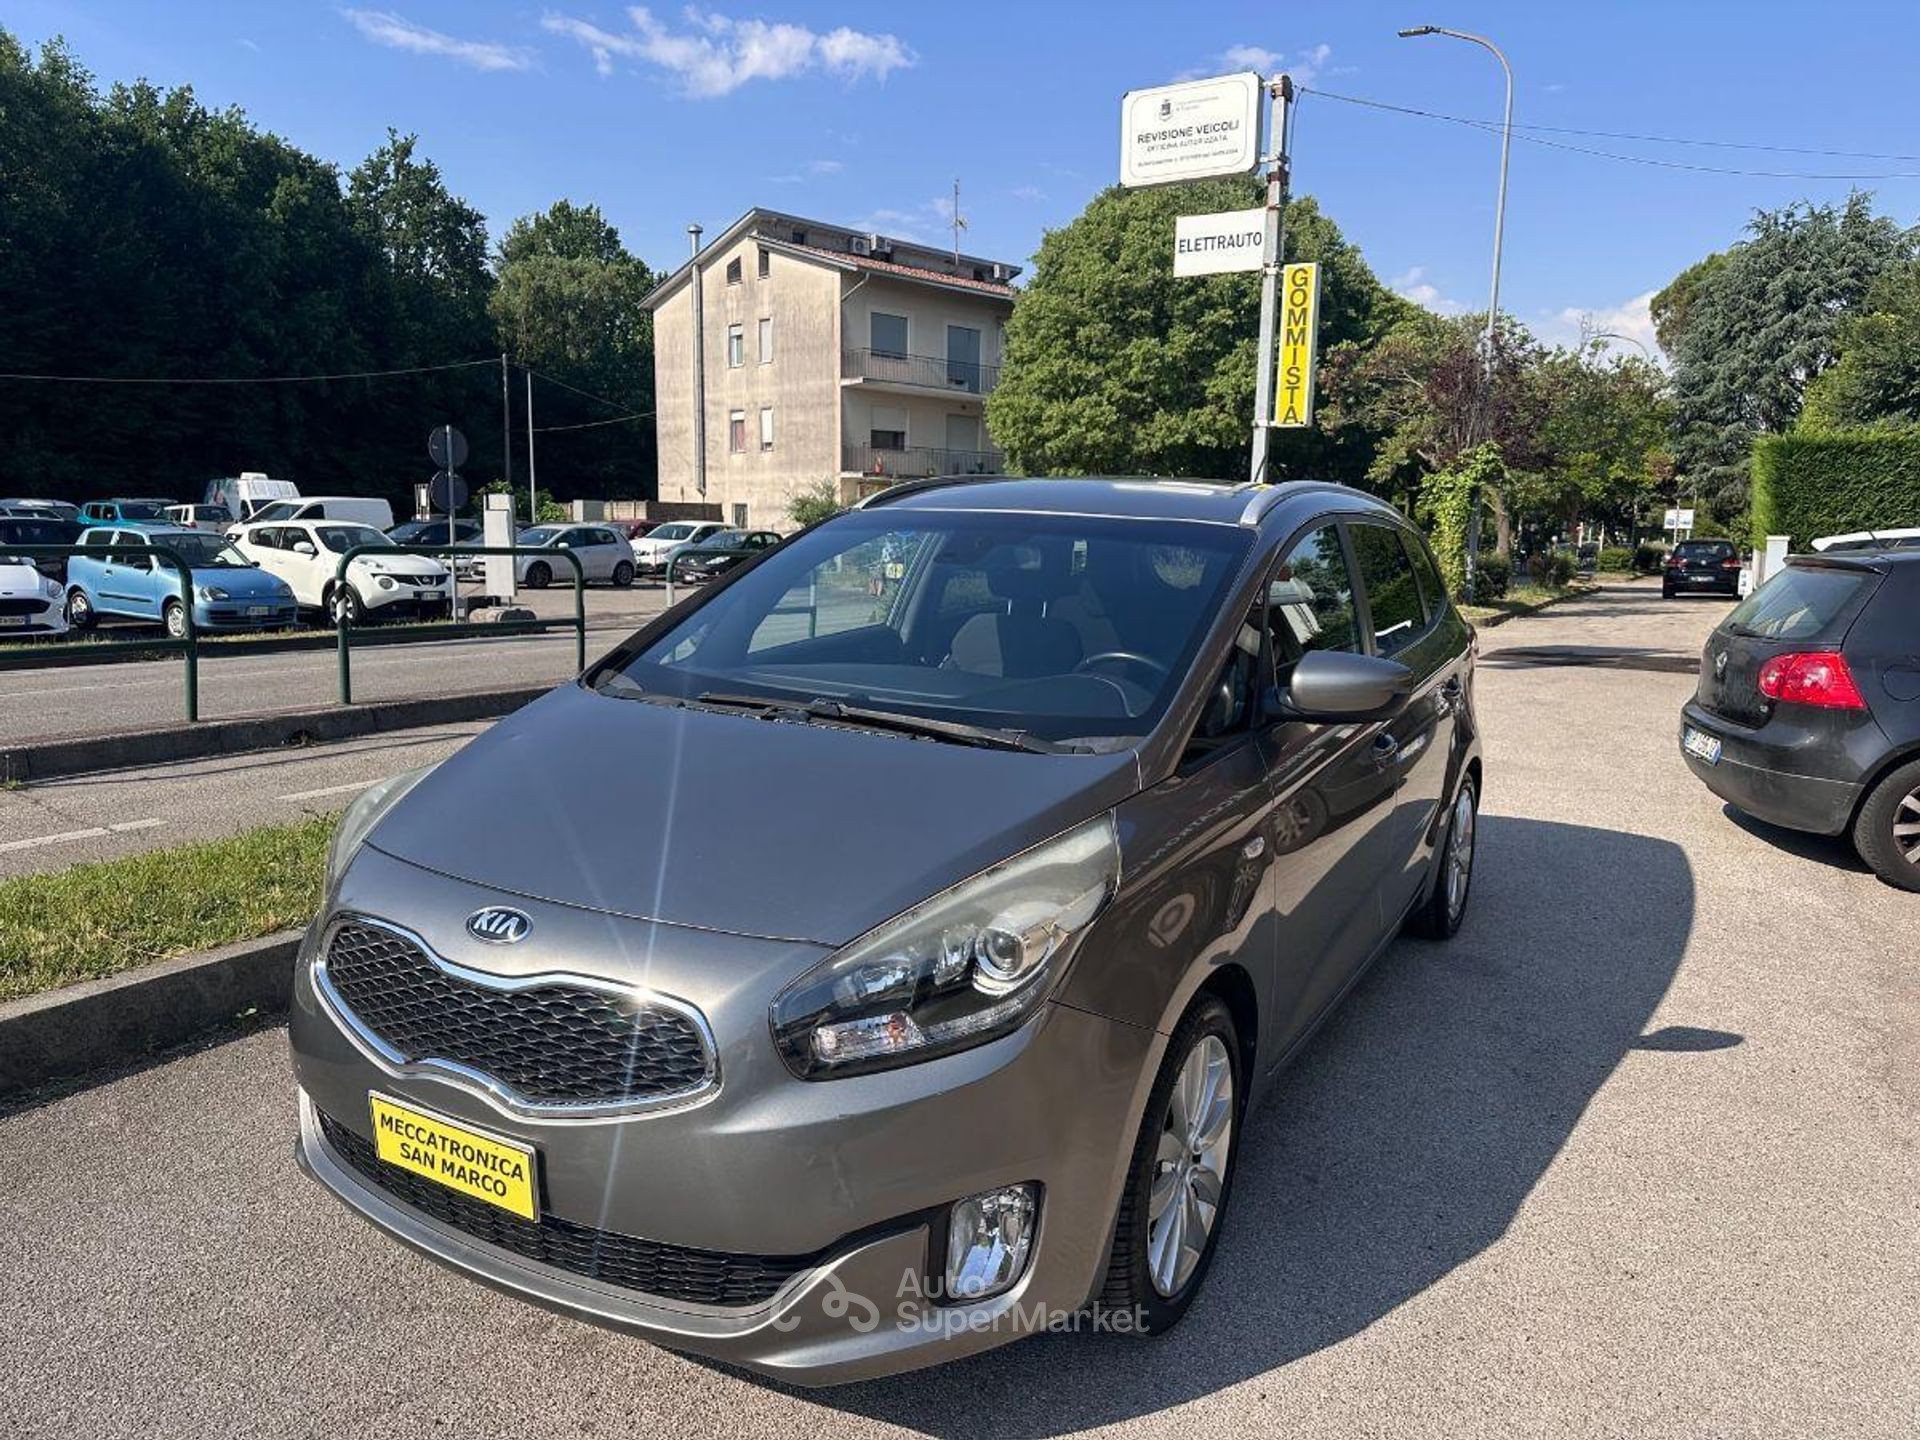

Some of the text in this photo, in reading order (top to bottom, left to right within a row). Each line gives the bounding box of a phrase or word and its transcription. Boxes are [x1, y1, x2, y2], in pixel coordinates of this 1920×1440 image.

[1137, 119, 1240, 144] REVISIONE VEICOLI
[1178, 231, 1262, 253] ELETTRAUTO
[1282, 267, 1309, 424] GOMMISTA
[473, 911, 519, 939] KIA
[380, 1112, 524, 1182] MECCATRONICA
[400, 1142, 507, 1197] SAN MARCO
